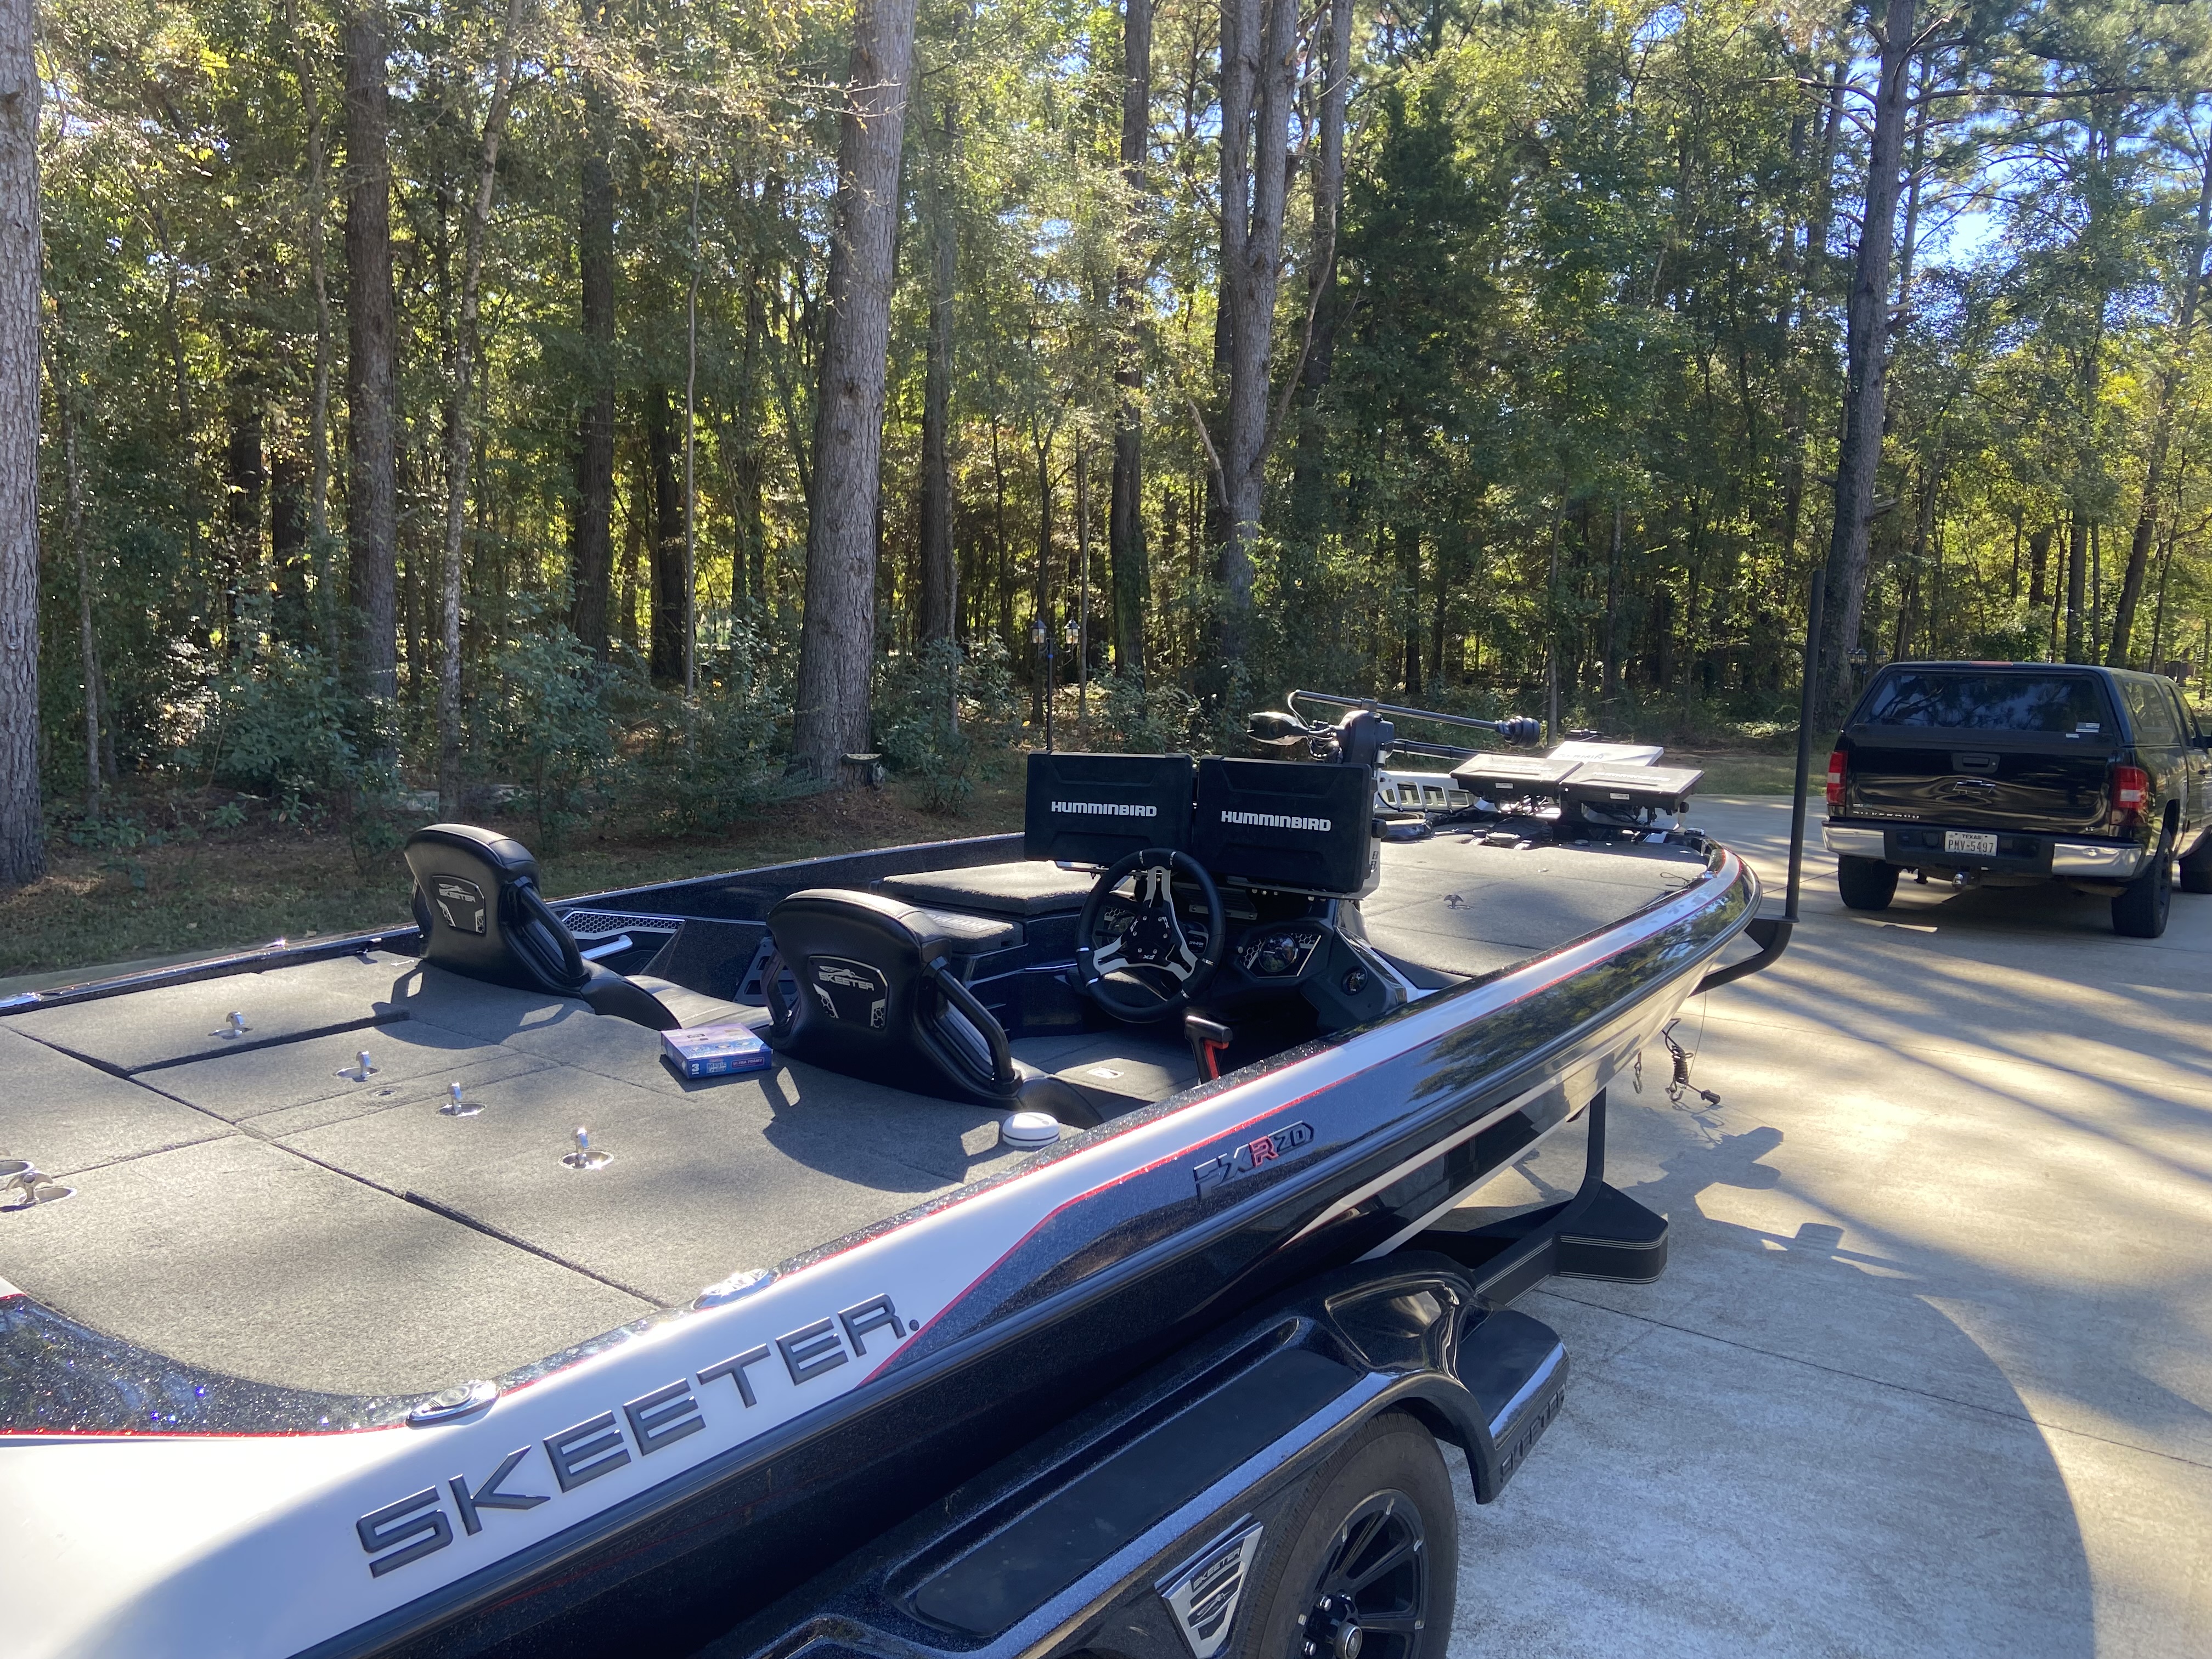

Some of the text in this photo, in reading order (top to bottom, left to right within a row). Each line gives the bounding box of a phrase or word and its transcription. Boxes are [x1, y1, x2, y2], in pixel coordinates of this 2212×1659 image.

[1051, 801, 1157, 817] HUMMINBIRD
[1221, 810, 1331, 832] HUMMINBIRD
[439, 888, 476, 902] SKEETER
[933, 916, 989, 929] YAMAHA
[819, 972, 874, 991] SKEETER
[692, 1063, 699, 1072] 3
[1193, 1547, 1241, 1590] SKEETER
